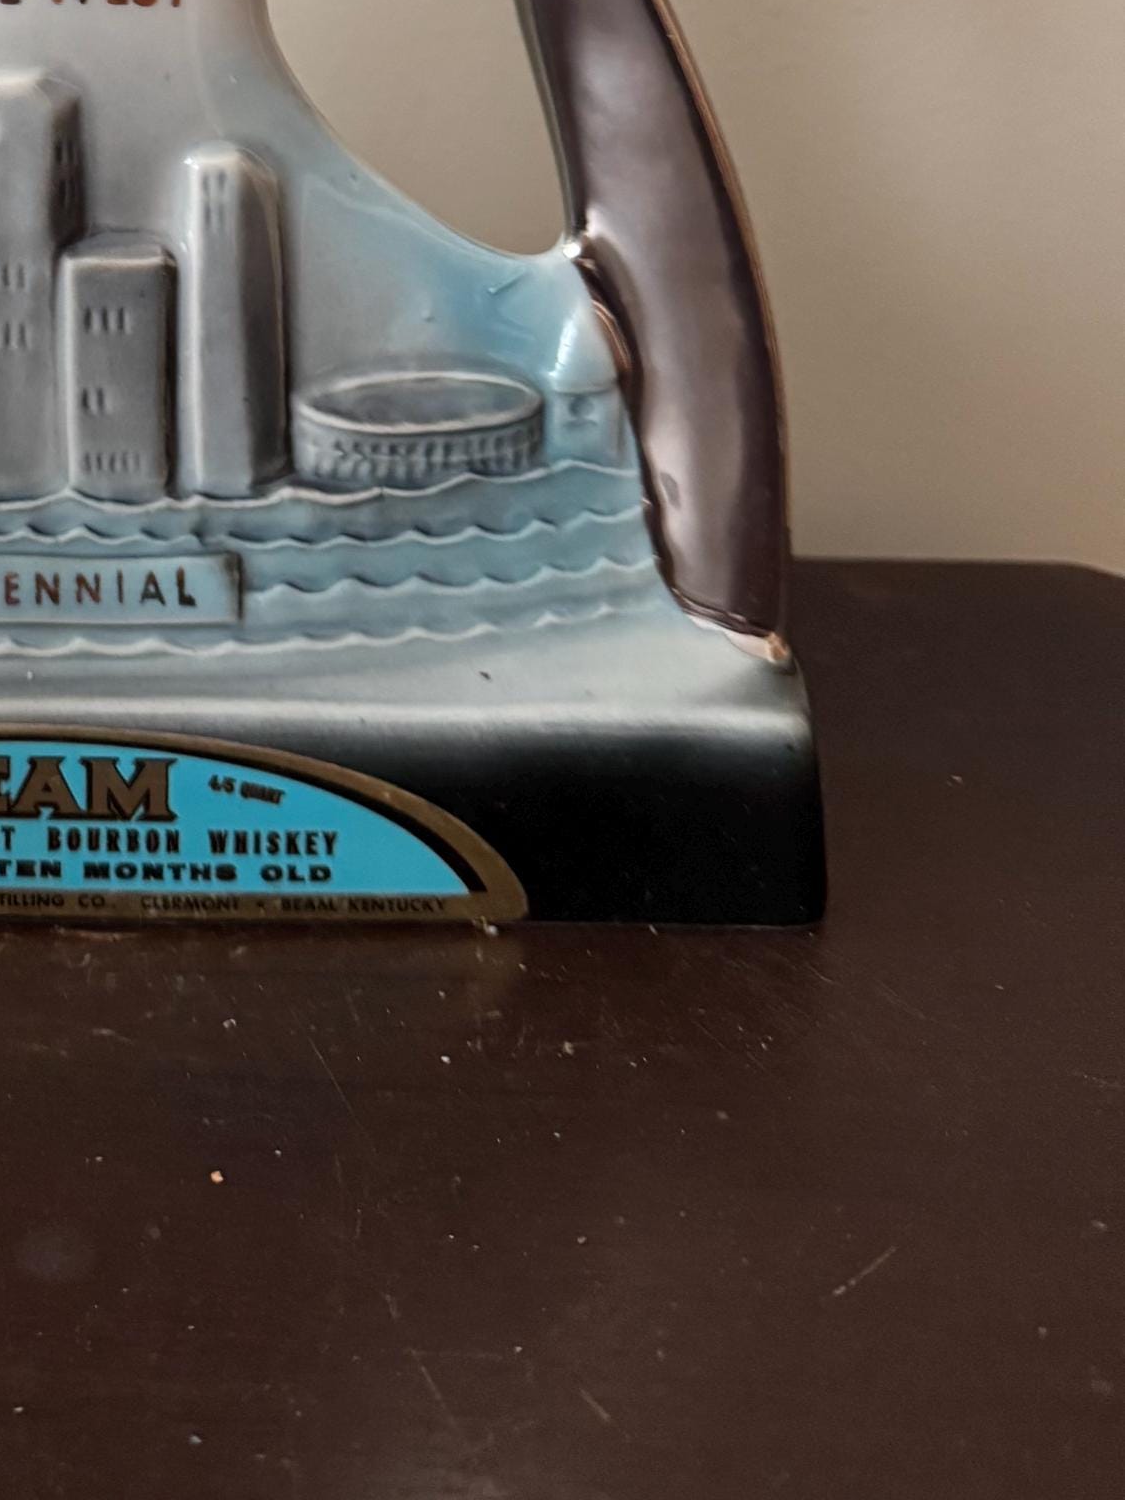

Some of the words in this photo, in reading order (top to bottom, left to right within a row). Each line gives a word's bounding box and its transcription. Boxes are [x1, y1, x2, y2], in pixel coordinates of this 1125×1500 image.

[48, 827, 180, 856] BOURBON
[208, 830, 338, 857] WHISKEY
[83, 861, 237, 882] MONTHS
[260, 864, 332, 882] OLD
[347, 897, 445, 912] KENTUCKY
